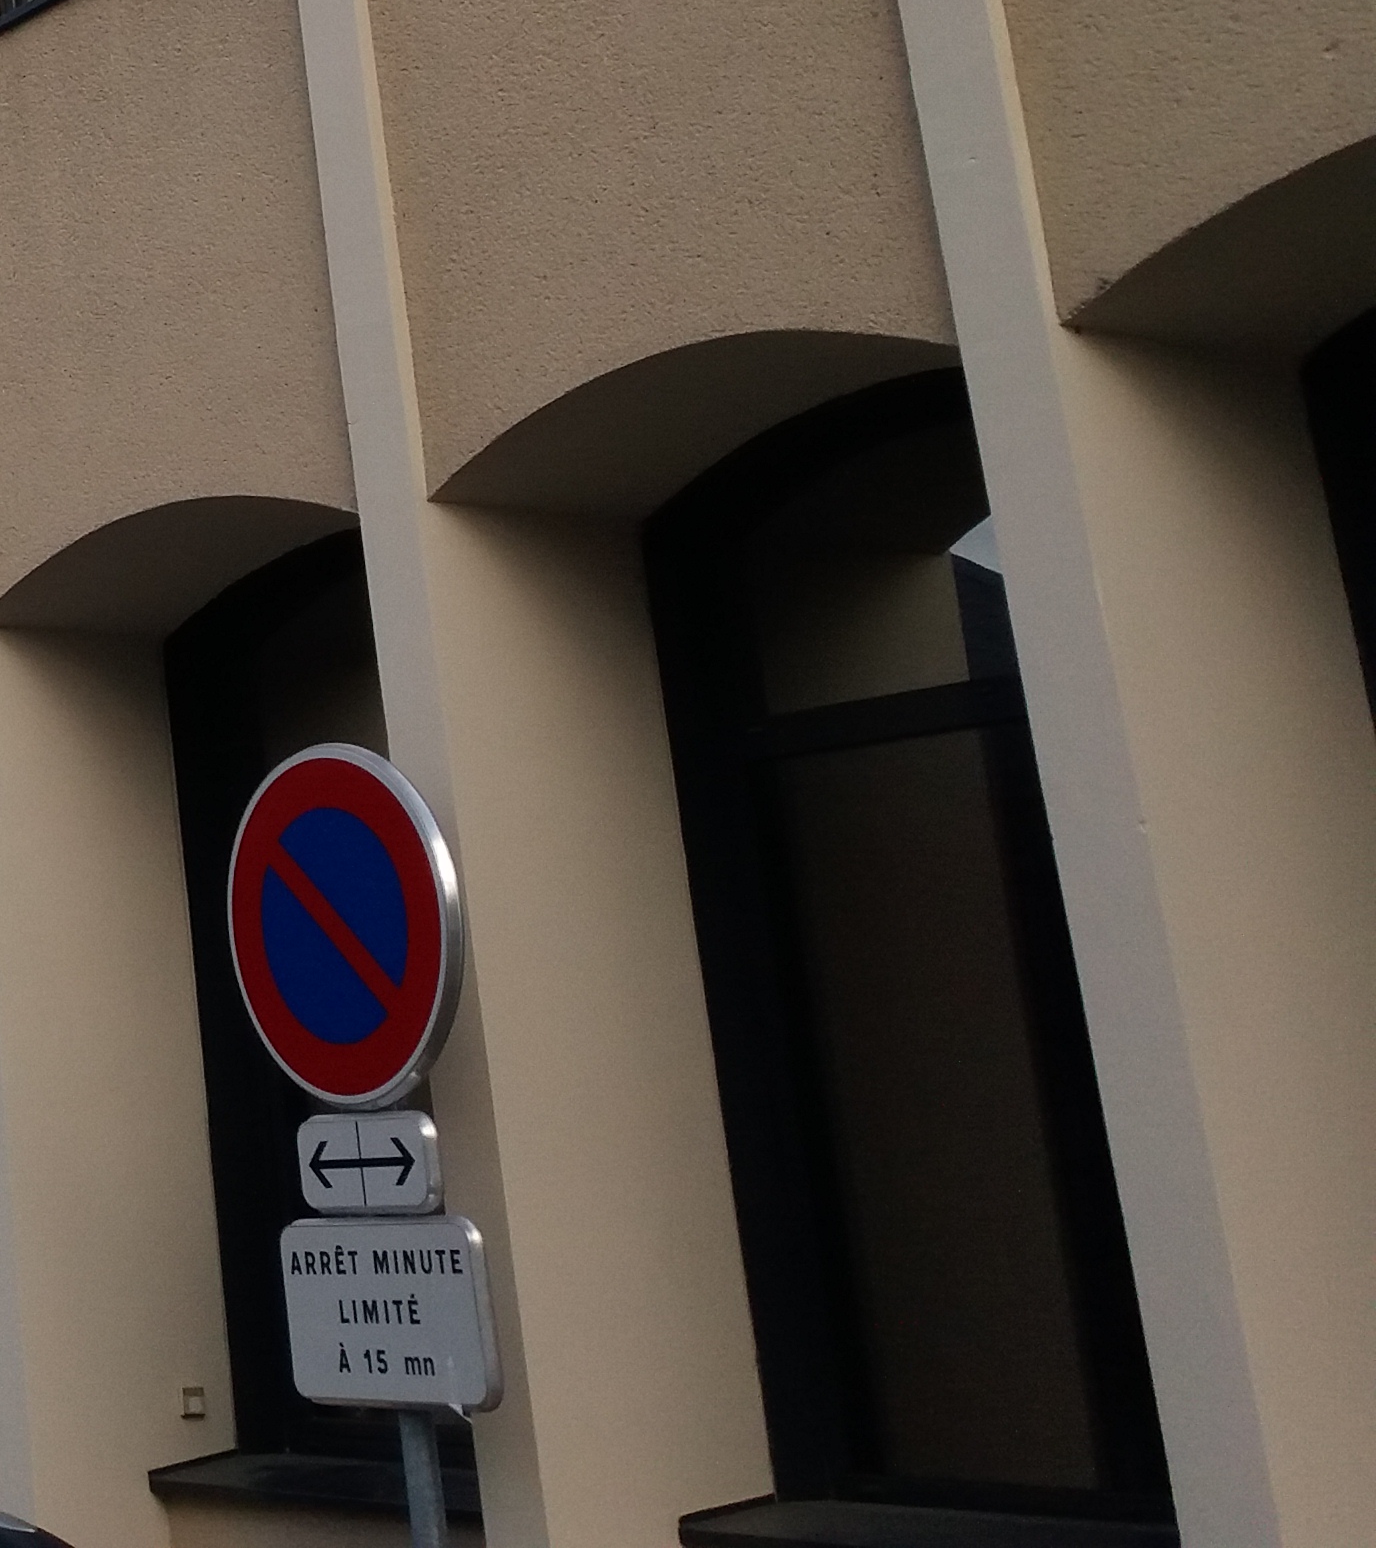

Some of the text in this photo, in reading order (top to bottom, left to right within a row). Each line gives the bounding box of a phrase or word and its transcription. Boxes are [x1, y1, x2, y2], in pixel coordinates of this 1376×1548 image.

[290, 1245, 464, 1276] ARRÊT MINUTE
[338, 1293, 421, 1325] LIMITÉ
[339, 1342, 437, 1377] À 15 mn
